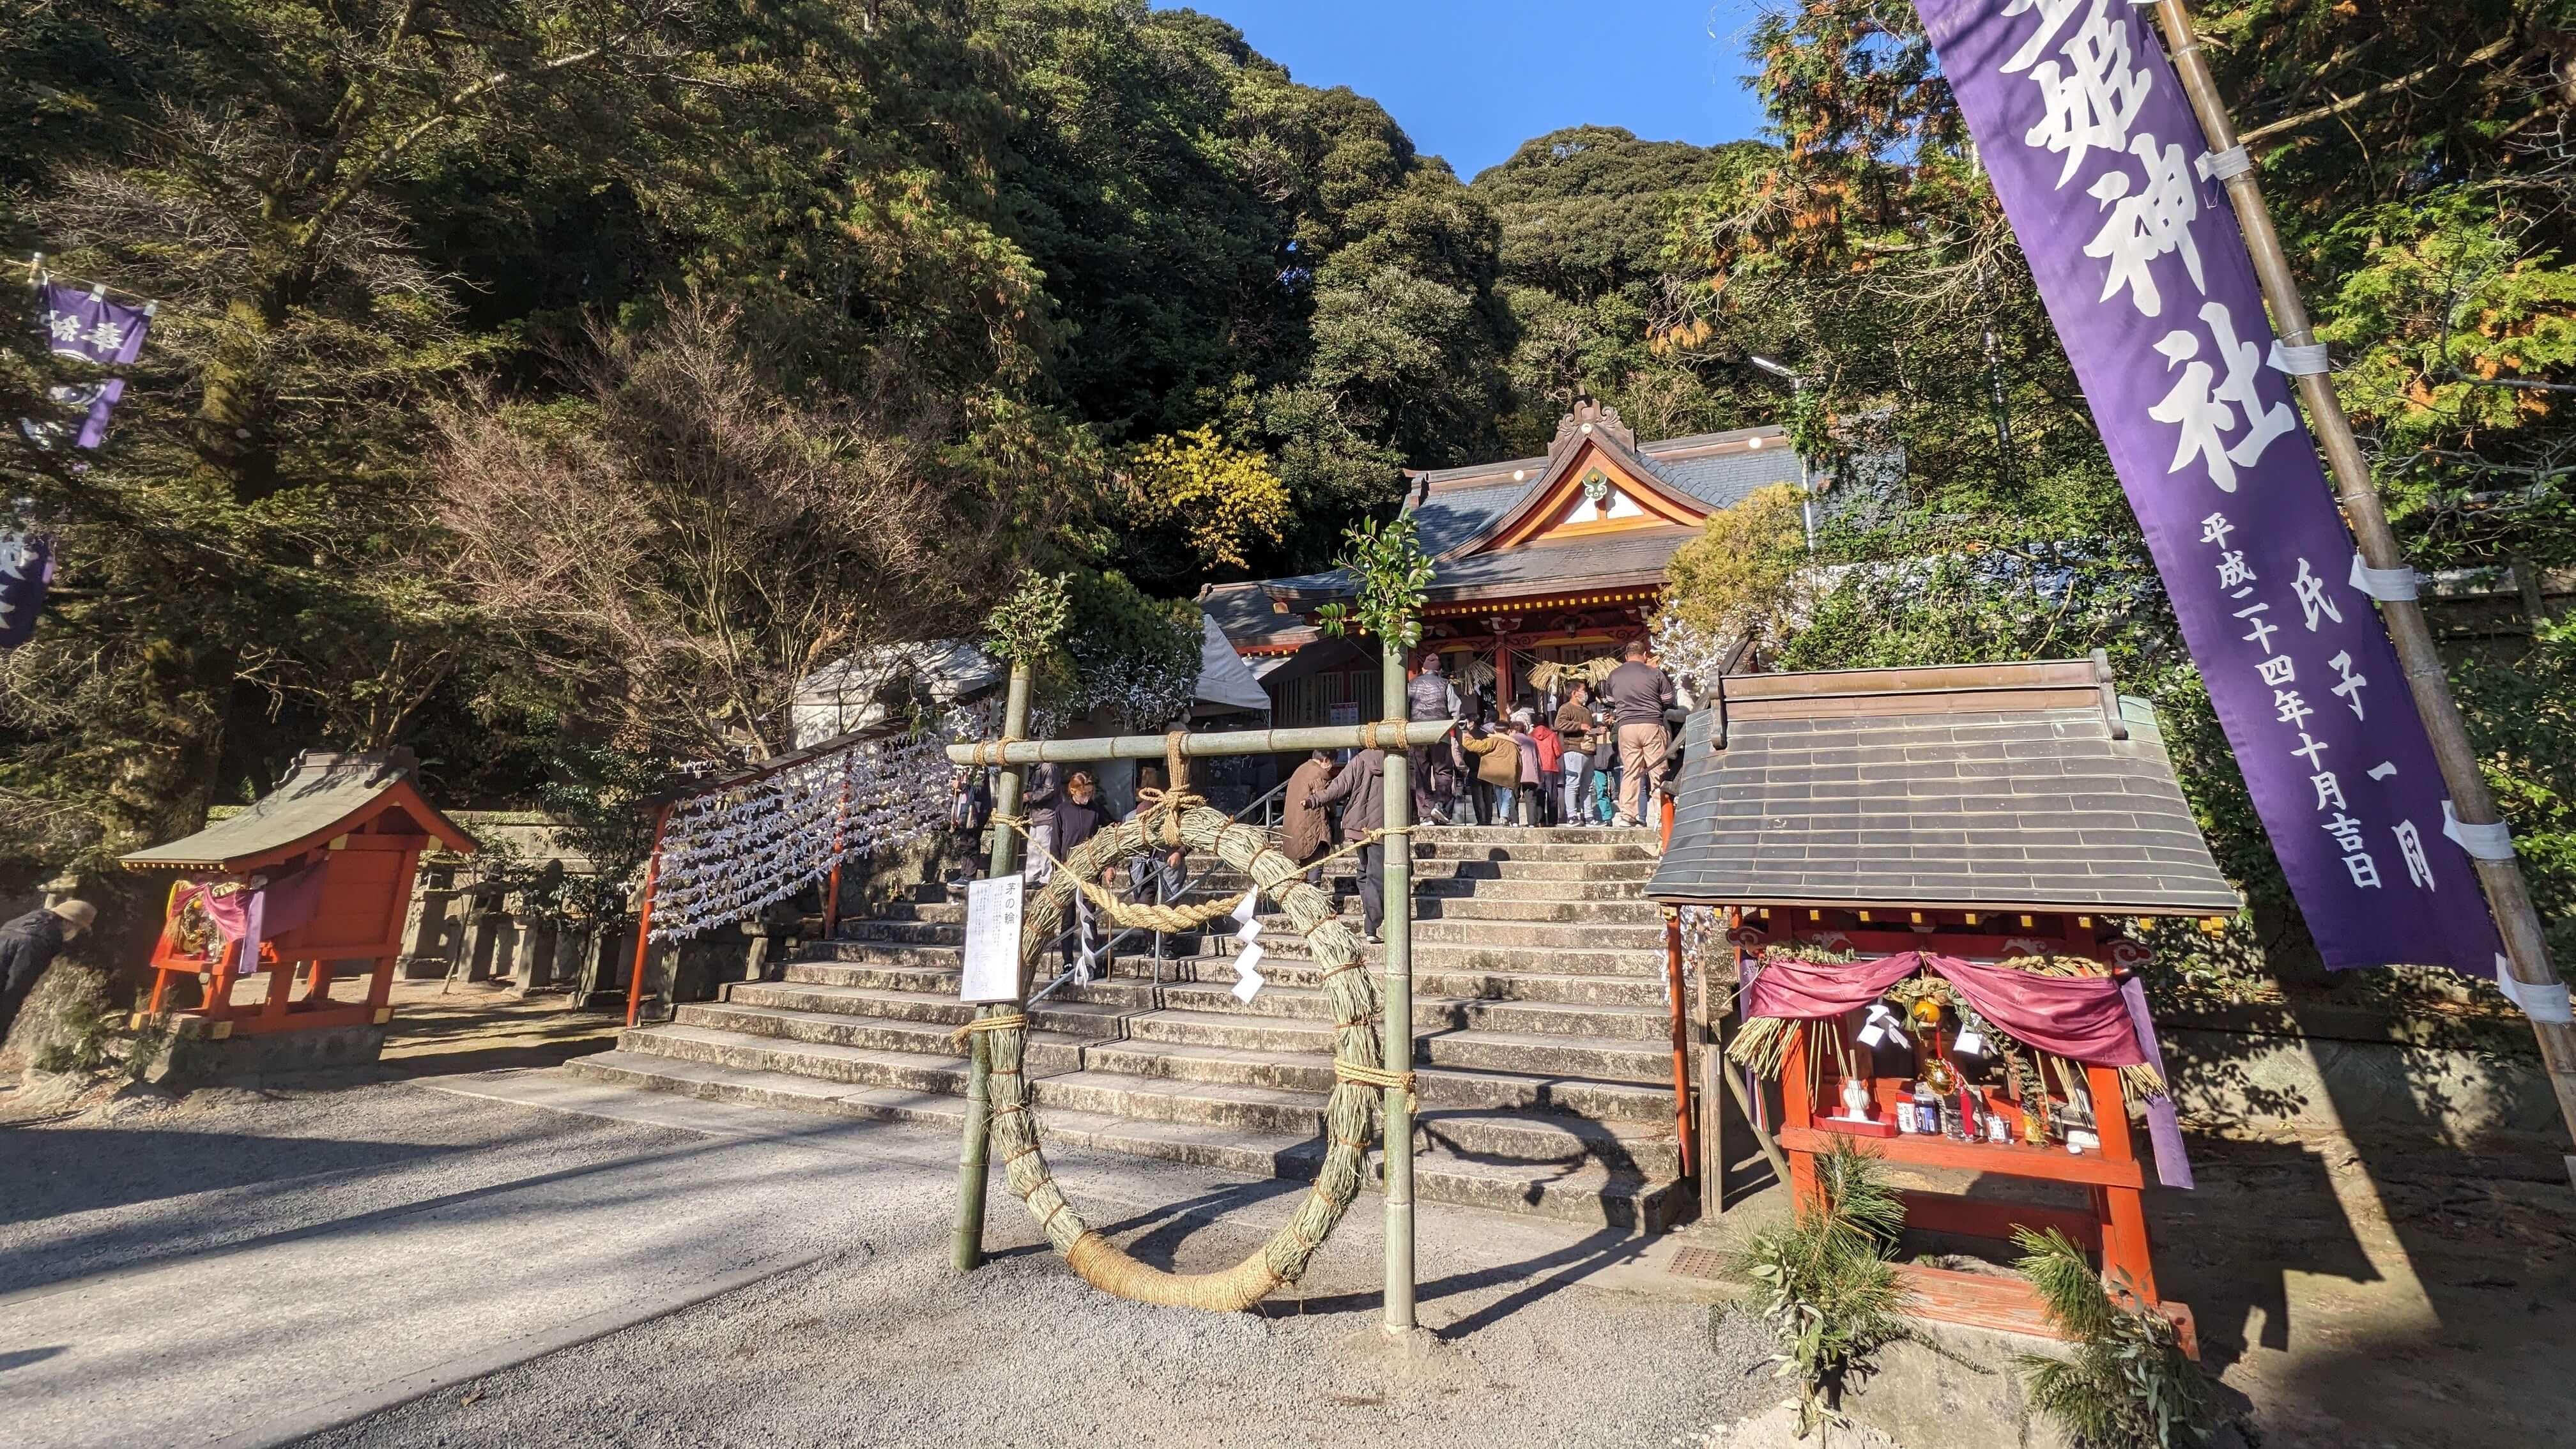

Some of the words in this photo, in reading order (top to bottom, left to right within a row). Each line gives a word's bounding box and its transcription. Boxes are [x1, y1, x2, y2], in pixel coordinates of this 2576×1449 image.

[2199, 512, 2382, 890] 平成二十四年十月吉日
[1005, 882, 1016, 924] 茅の輪
